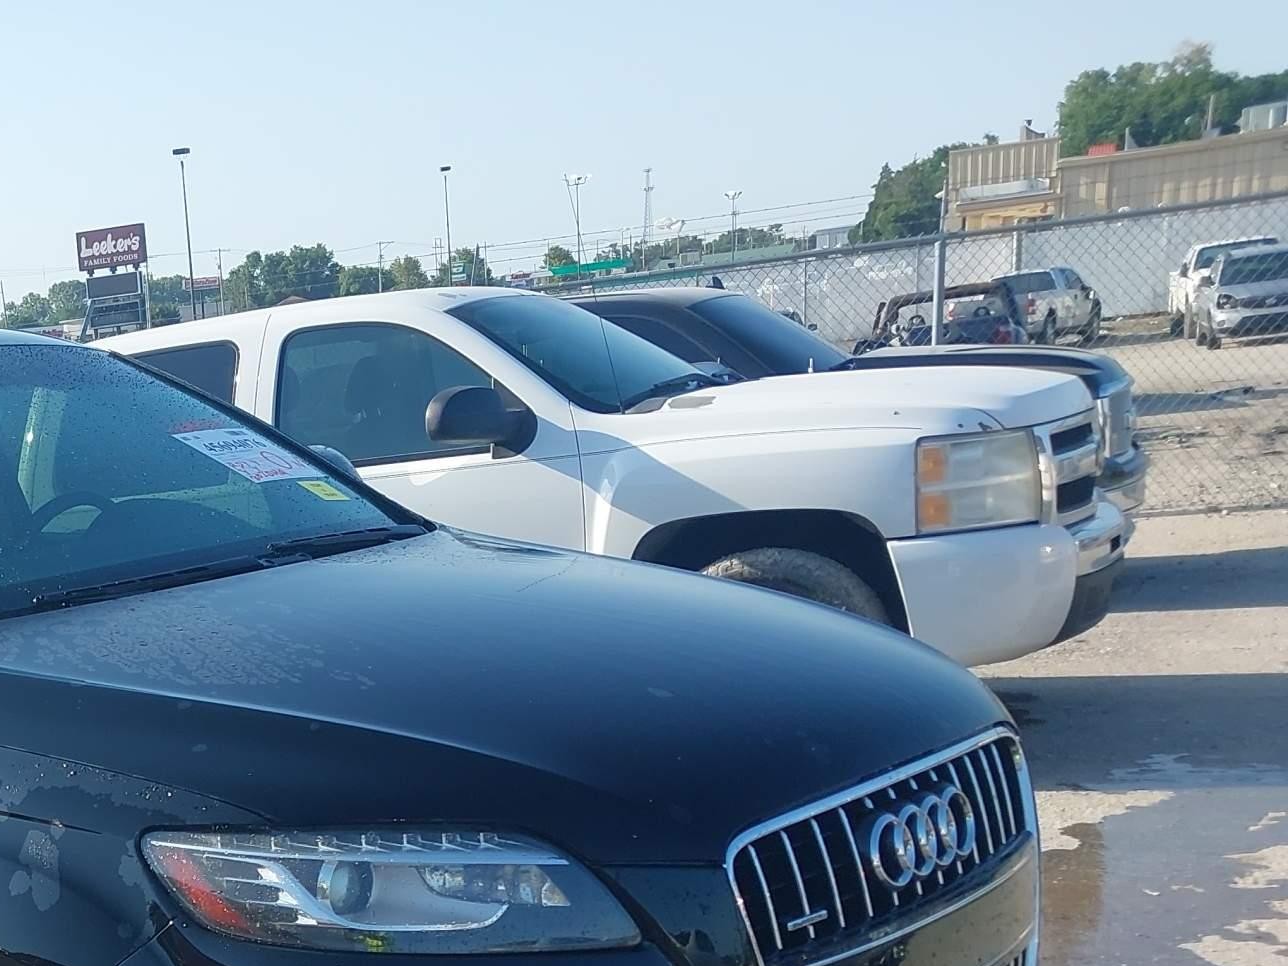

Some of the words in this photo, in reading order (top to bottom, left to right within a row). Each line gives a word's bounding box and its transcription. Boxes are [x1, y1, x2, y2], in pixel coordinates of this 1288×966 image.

[80, 232, 140, 258] Leeker's
[84, 256, 111, 267] FAMILY
[113, 253, 139, 263] FOODS
[202, 438, 267, 453] 45694076
